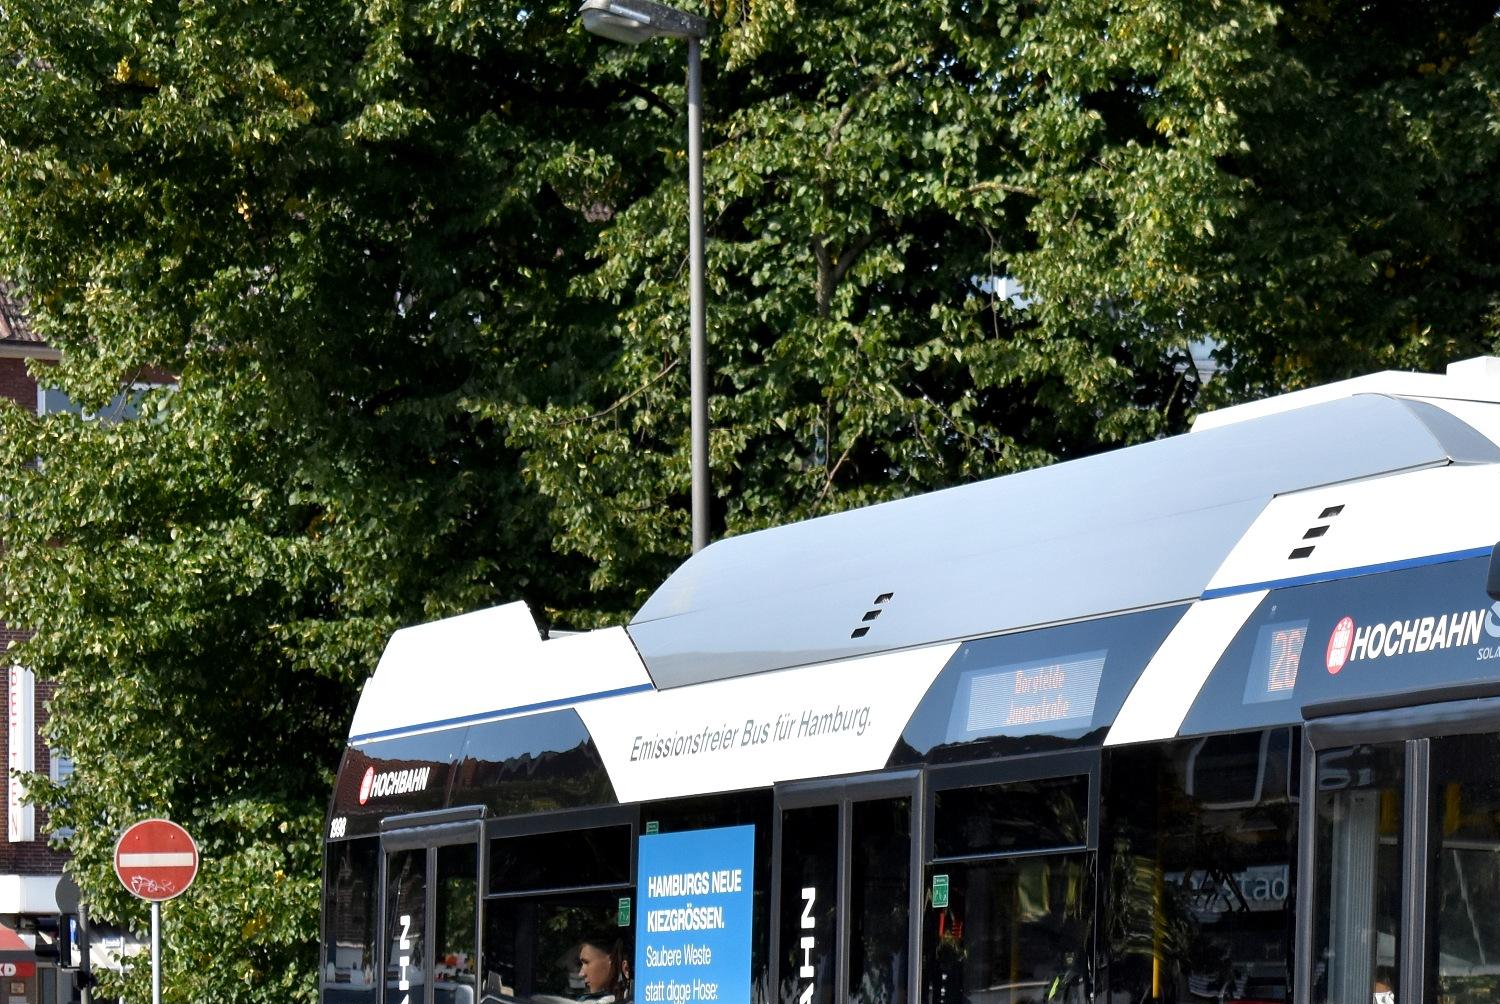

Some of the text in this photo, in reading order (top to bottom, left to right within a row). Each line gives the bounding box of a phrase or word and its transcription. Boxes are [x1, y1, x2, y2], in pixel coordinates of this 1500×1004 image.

[1350, 609, 1485, 661] HOCHBAHN
[629, 705, 872, 762] Emissionsfreier Bus für Hamburg.
[369, 766, 430, 798] HOCHBAHN
[648, 869, 742, 898] HAMBURGS NEUE
[647, 903, 725, 933] KIEZGRÖSSEN.
[646, 943, 712, 967] Saubere Weste
[645, 981, 664, 1002] statt
[692, 978, 719, 1001] Hose:
